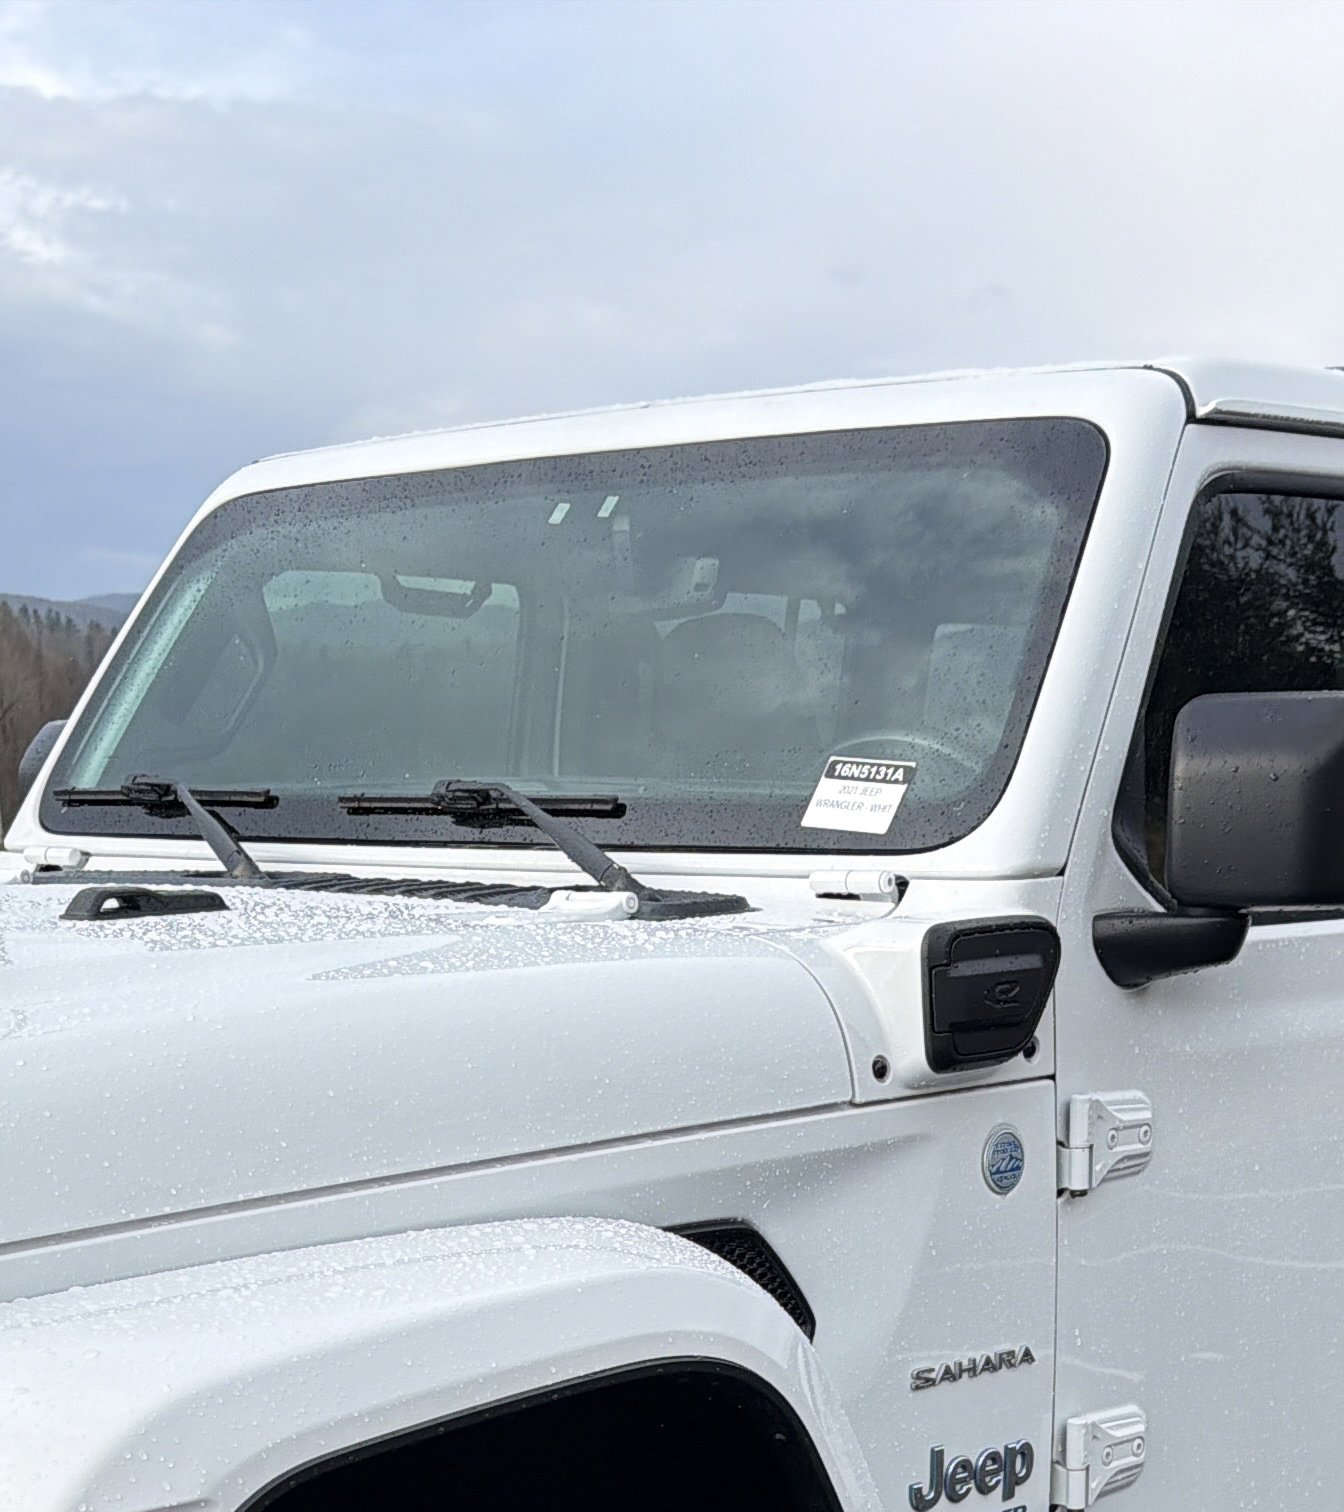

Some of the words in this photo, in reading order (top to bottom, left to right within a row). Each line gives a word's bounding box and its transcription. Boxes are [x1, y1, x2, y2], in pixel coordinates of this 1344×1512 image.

[834, 762, 905, 782] 16N5131A
[838, 785, 859, 795] 2021
[858, 786, 882, 797] JEEP
[816, 799, 864, 811] WRANGLER
[869, 804, 894, 814] WHIT
[910, 1345, 1036, 1391] SAHARA
[909, 1438, 1034, 1512] Jeep
